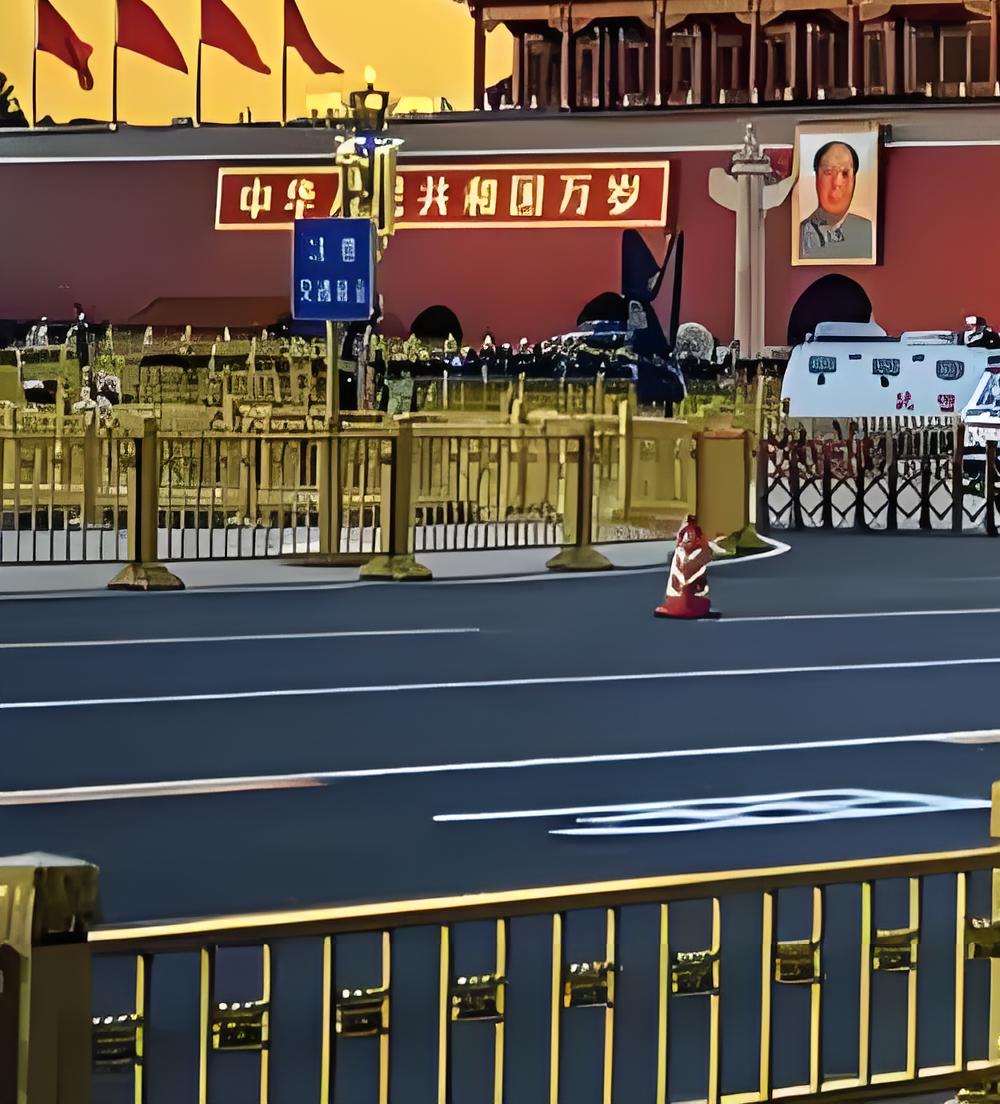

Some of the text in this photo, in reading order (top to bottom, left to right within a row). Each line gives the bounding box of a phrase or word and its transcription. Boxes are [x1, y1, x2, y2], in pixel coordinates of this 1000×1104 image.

[240, 174, 640, 219] 中华共和国万岁
